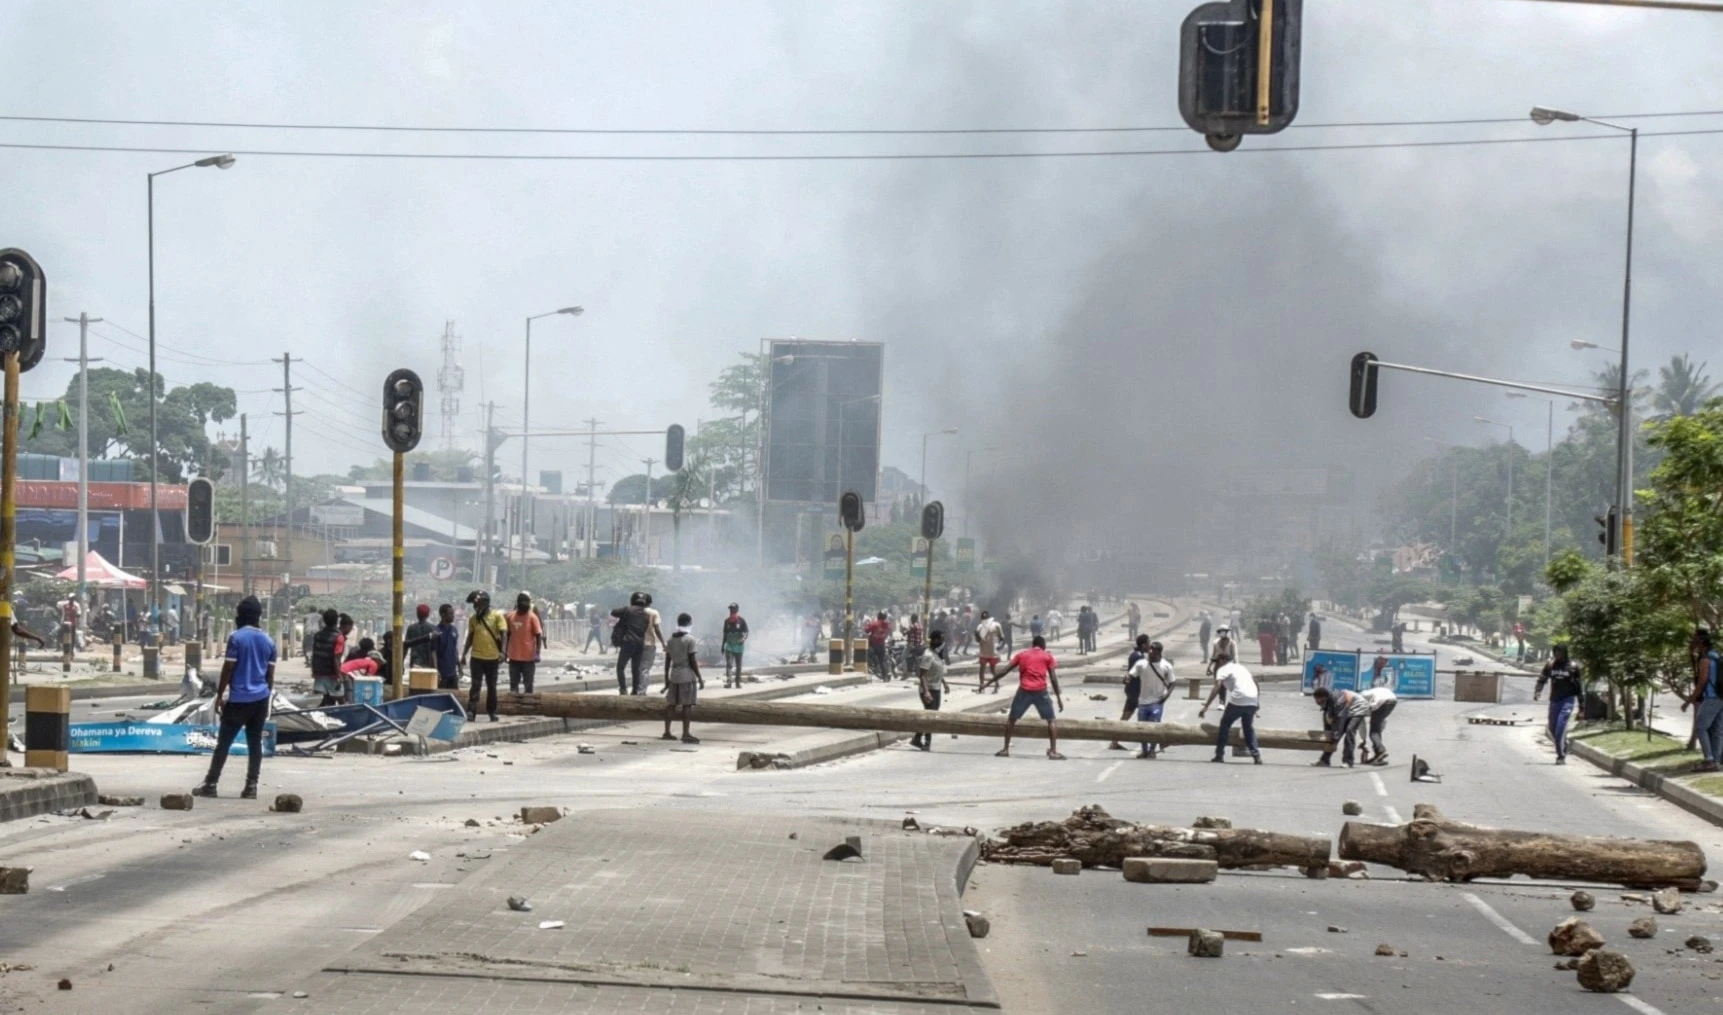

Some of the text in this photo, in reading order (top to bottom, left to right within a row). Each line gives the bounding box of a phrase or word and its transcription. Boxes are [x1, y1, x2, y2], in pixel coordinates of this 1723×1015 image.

[436, 559, 450, 577] P
[70, 726, 162, 737] Dhamana ya Dereva
[71, 737, 101, 748] Makini
